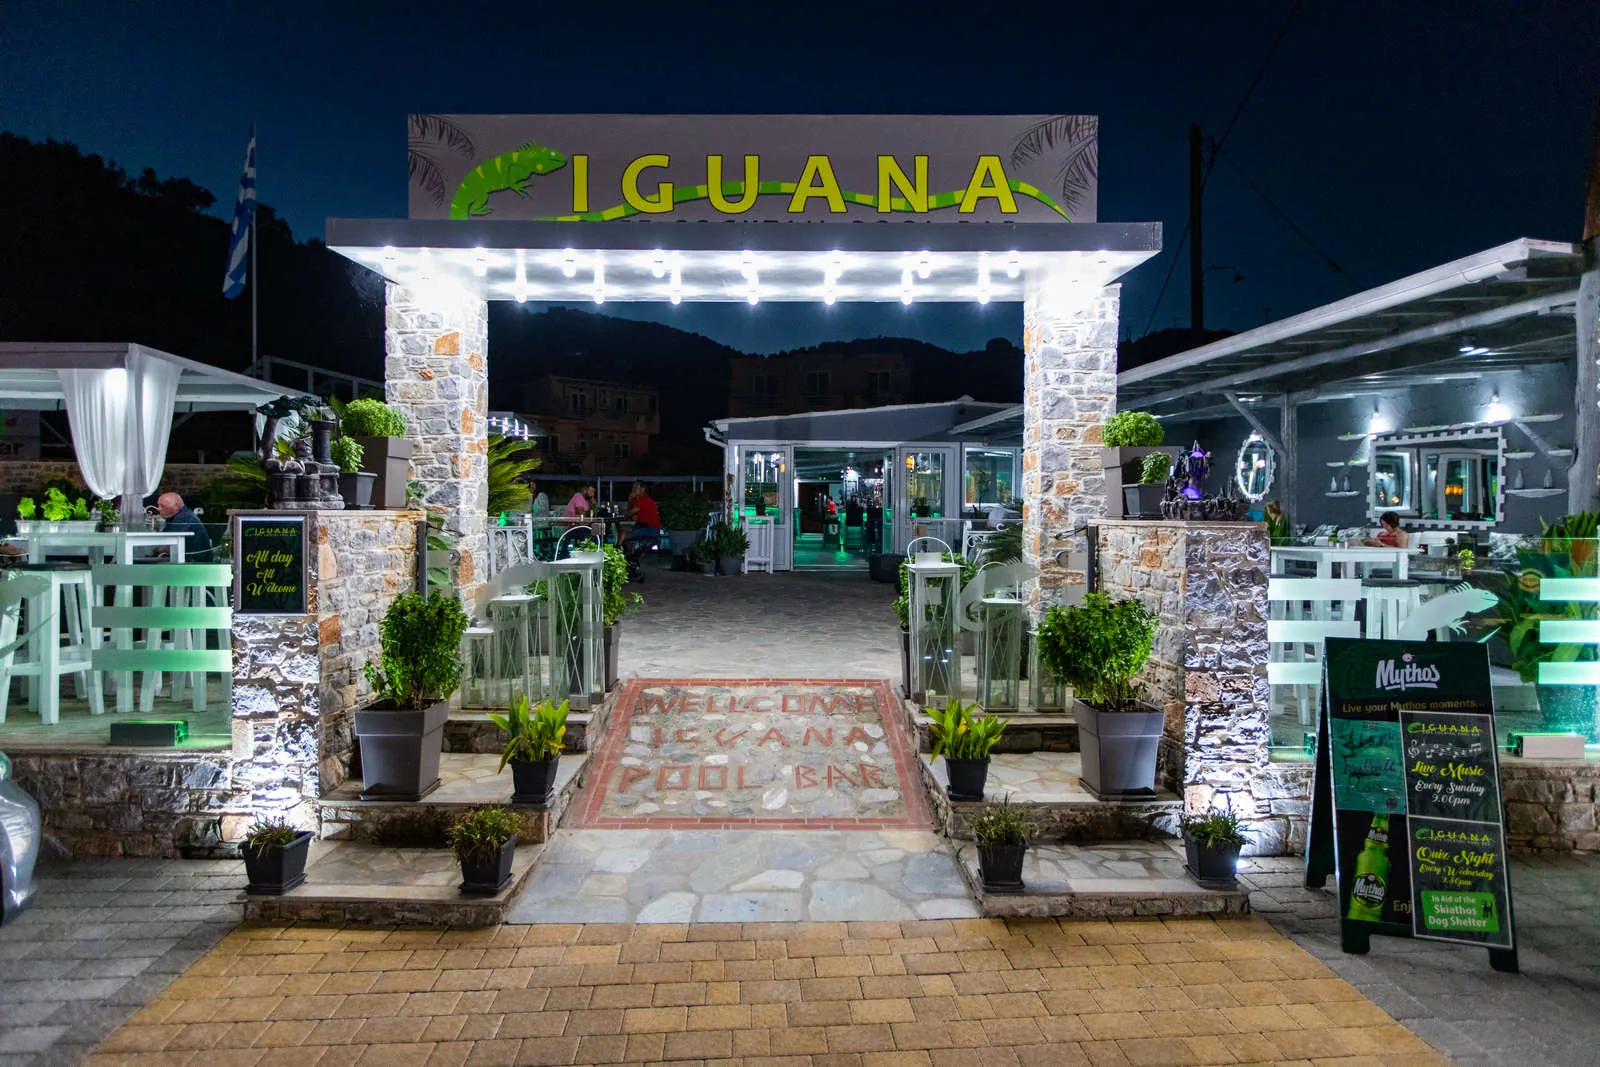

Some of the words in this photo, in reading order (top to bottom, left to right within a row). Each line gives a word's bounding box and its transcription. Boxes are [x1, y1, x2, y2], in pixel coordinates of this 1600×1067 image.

[571, 153, 1019, 214] IGUANA
[254, 527, 297, 535] IGUANA
[246, 549, 269, 568] All
[270, 549, 294, 568] day
[256, 568, 275, 583] All
[246, 582, 297, 596] Welcome
[1376, 659, 1440, 691] Mythos
[1342, 704, 1362, 713] Live
[1365, 704, 1388, 714] your
[1390, 701, 1427, 712] Mythos
[1422, 723, 1480, 734] IGUANA
[619, 764, 763, 793] POOL
[795, 764, 887, 790] BAR
[1411, 761, 1437, 776] Live
[1440, 762, 1485, 781] Music
[1415, 780, 1443, 793] Every
[1446, 782, 1485, 796] Sunday
[1430, 829, 1490, 843] IGUANA
[1416, 846, 1449, 865] Quiz
[1453, 850, 1495, 867] Night
[1353, 877, 1385, 901] Mythos
[1393, 900, 1413, 914] Enj
[1434, 904, 1478, 916] Skiathos
[1428, 915, 1449, 928] Dog
[1450, 916, 1488, 927] Shelter
